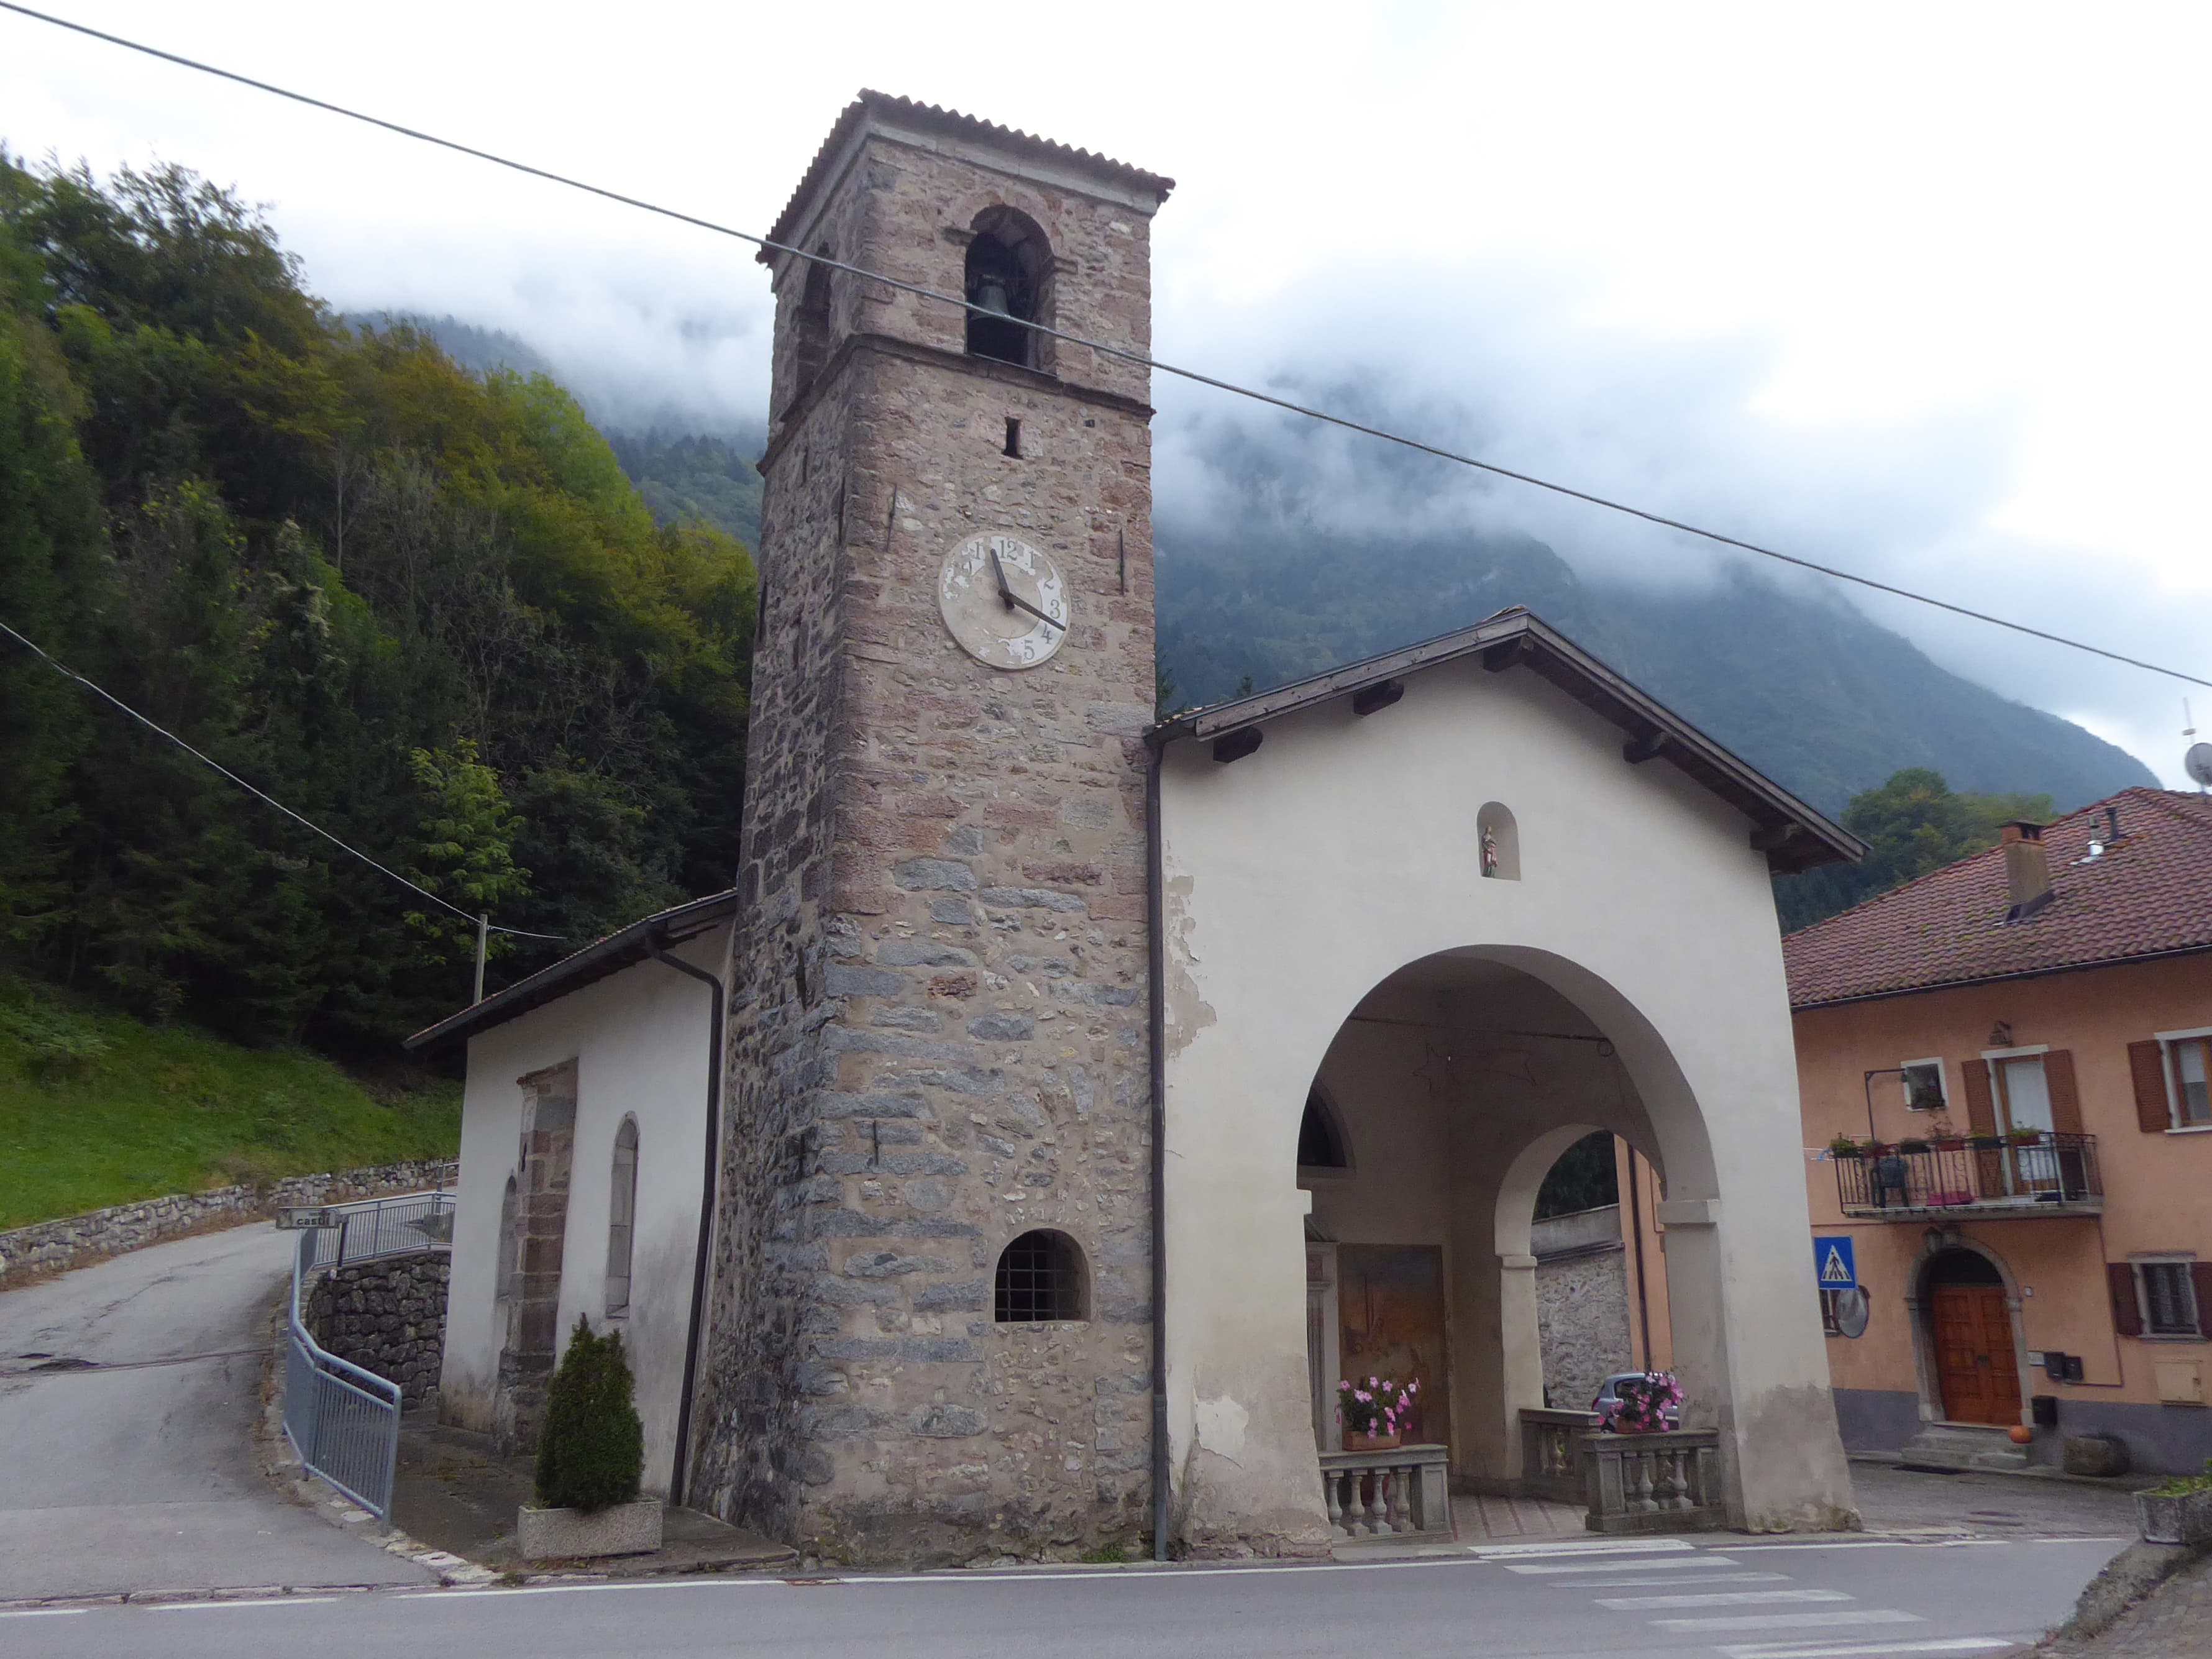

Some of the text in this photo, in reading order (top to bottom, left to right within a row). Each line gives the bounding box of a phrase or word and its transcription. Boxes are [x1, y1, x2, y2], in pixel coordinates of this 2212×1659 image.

[999, 539, 1017, 560] 12
[1028, 550, 1035, 569] 1
[1049, 599, 1061, 619] 3
[1040, 623, 1053, 645] 4
[1023, 639, 1035, 660] 5
